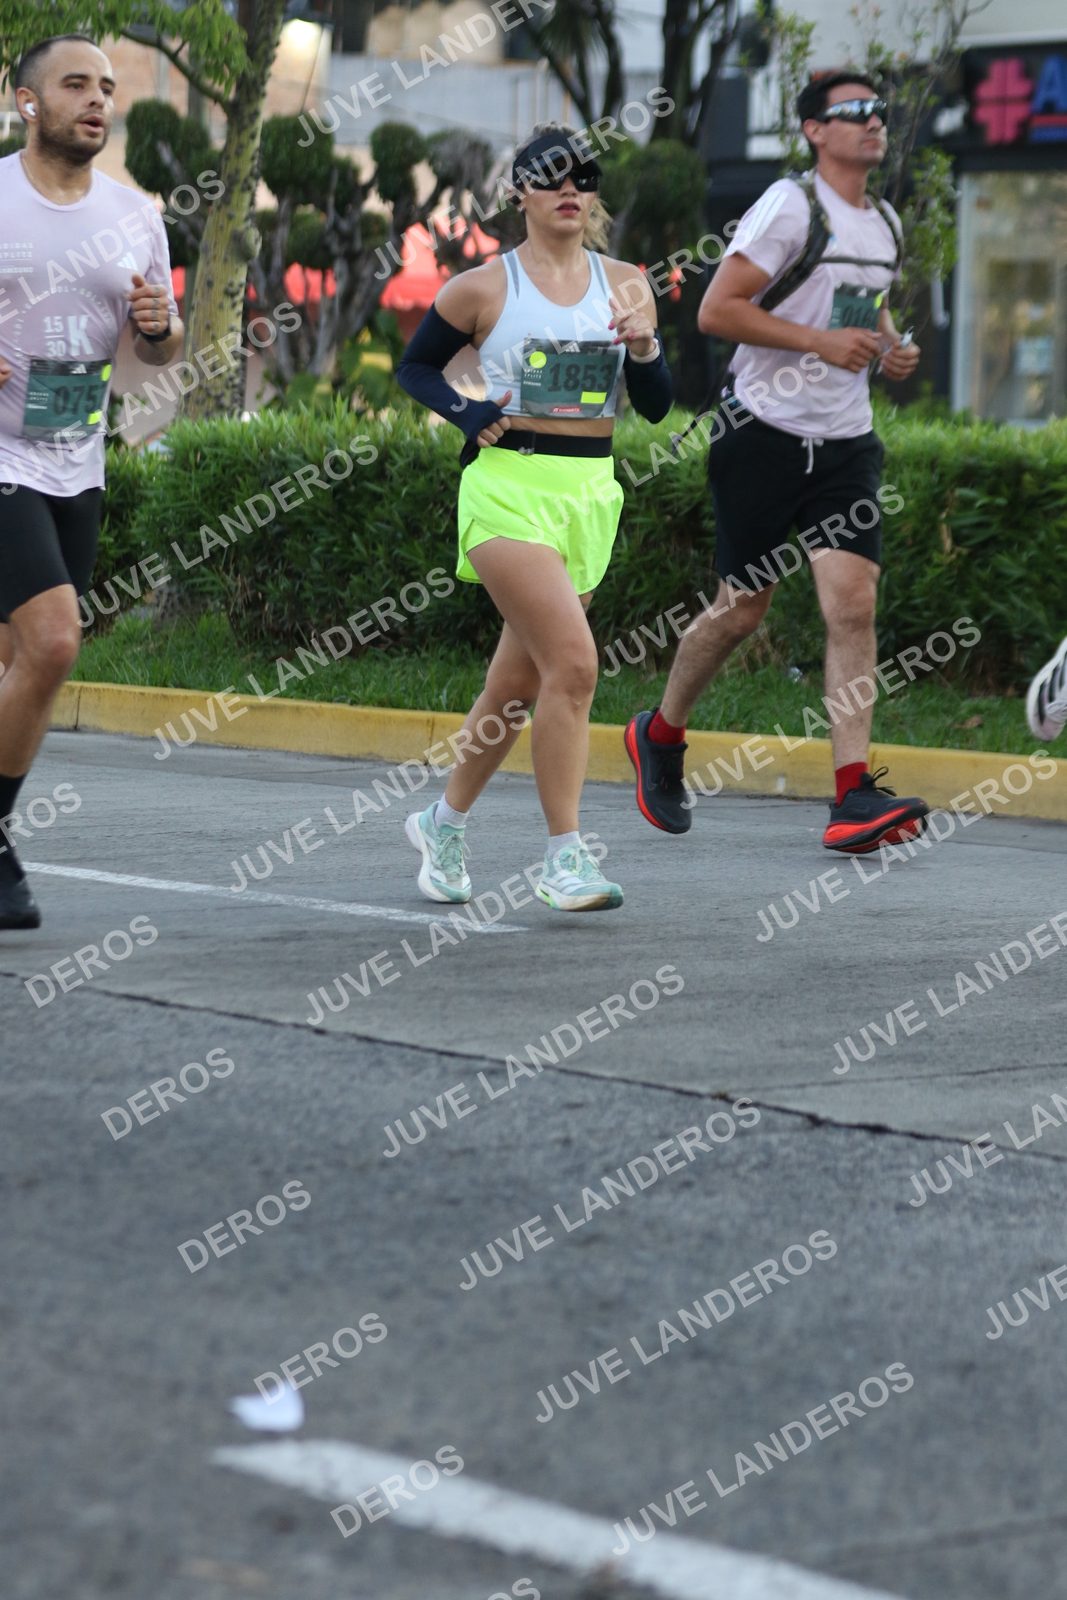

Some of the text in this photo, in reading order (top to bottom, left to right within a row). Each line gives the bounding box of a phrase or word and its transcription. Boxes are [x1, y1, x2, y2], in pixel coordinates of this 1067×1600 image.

[44, 315, 64, 333] 15
[67, 315, 94, 356] K
[46, 341, 66, 357] 30
[54, 384, 108, 416] 075
